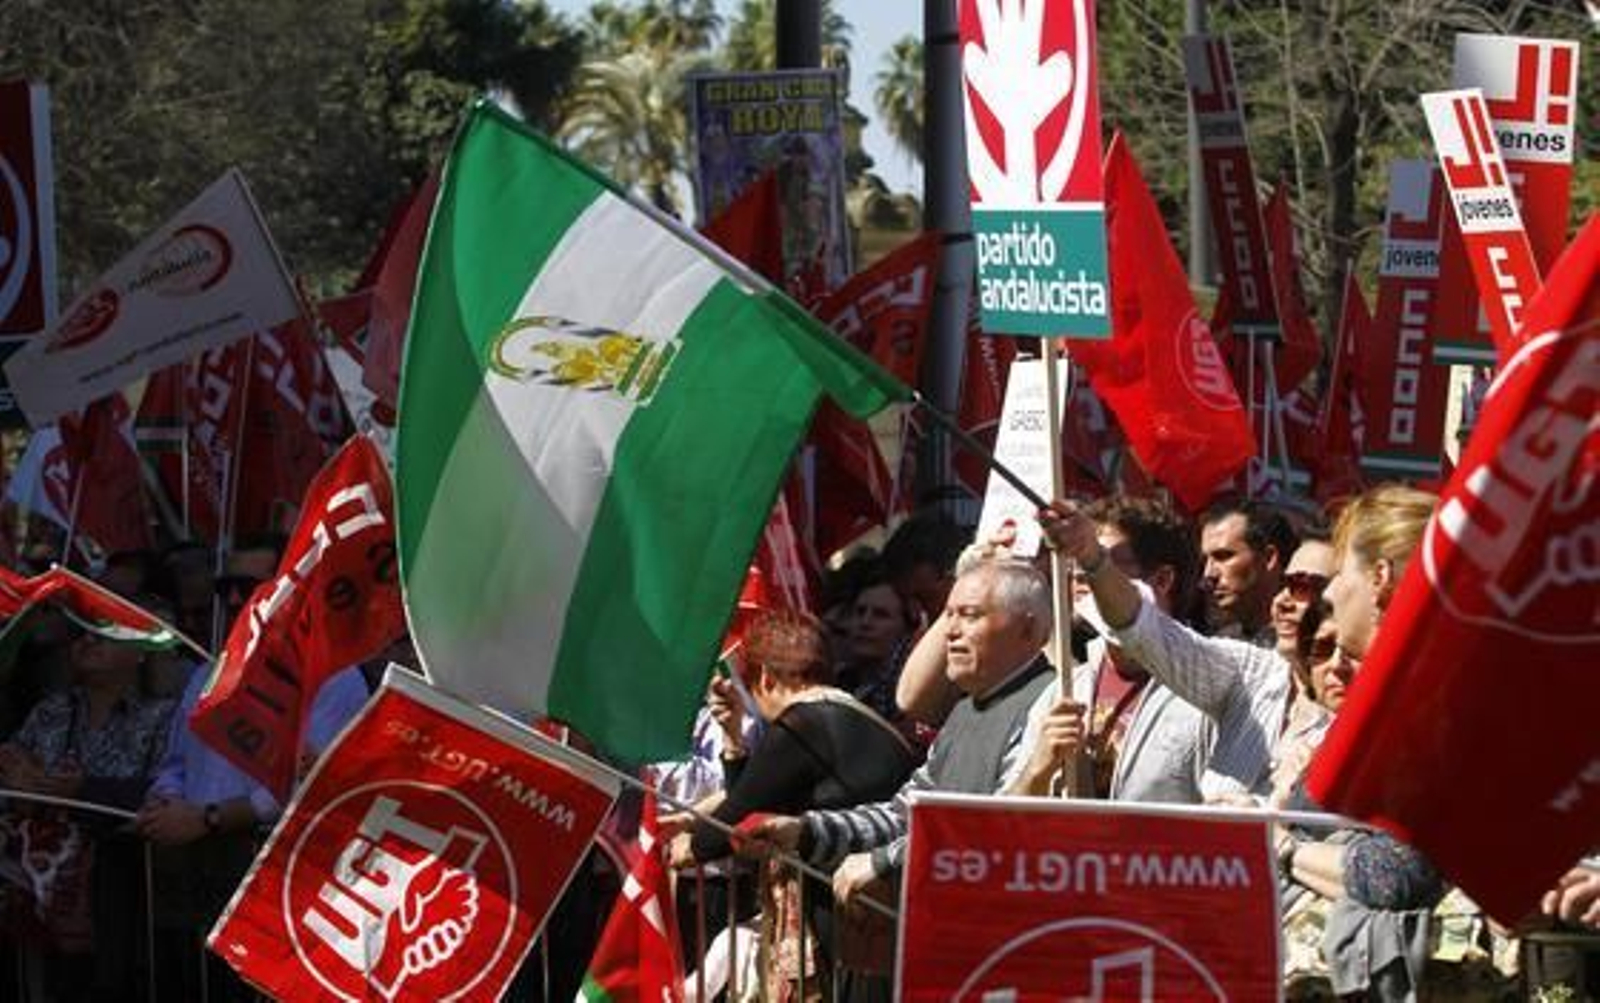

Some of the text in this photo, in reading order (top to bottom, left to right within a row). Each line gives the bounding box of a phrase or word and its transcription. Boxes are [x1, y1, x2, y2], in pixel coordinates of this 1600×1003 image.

[1497, 131, 1567, 152] enes
[976, 222, 1055, 274] partido
[980, 270, 1107, 316] andalucista
[1388, 289, 1430, 444] CCOO
[385, 717, 578, 832] www.UGT.es
[932, 848, 1250, 893] www.UGT.es
